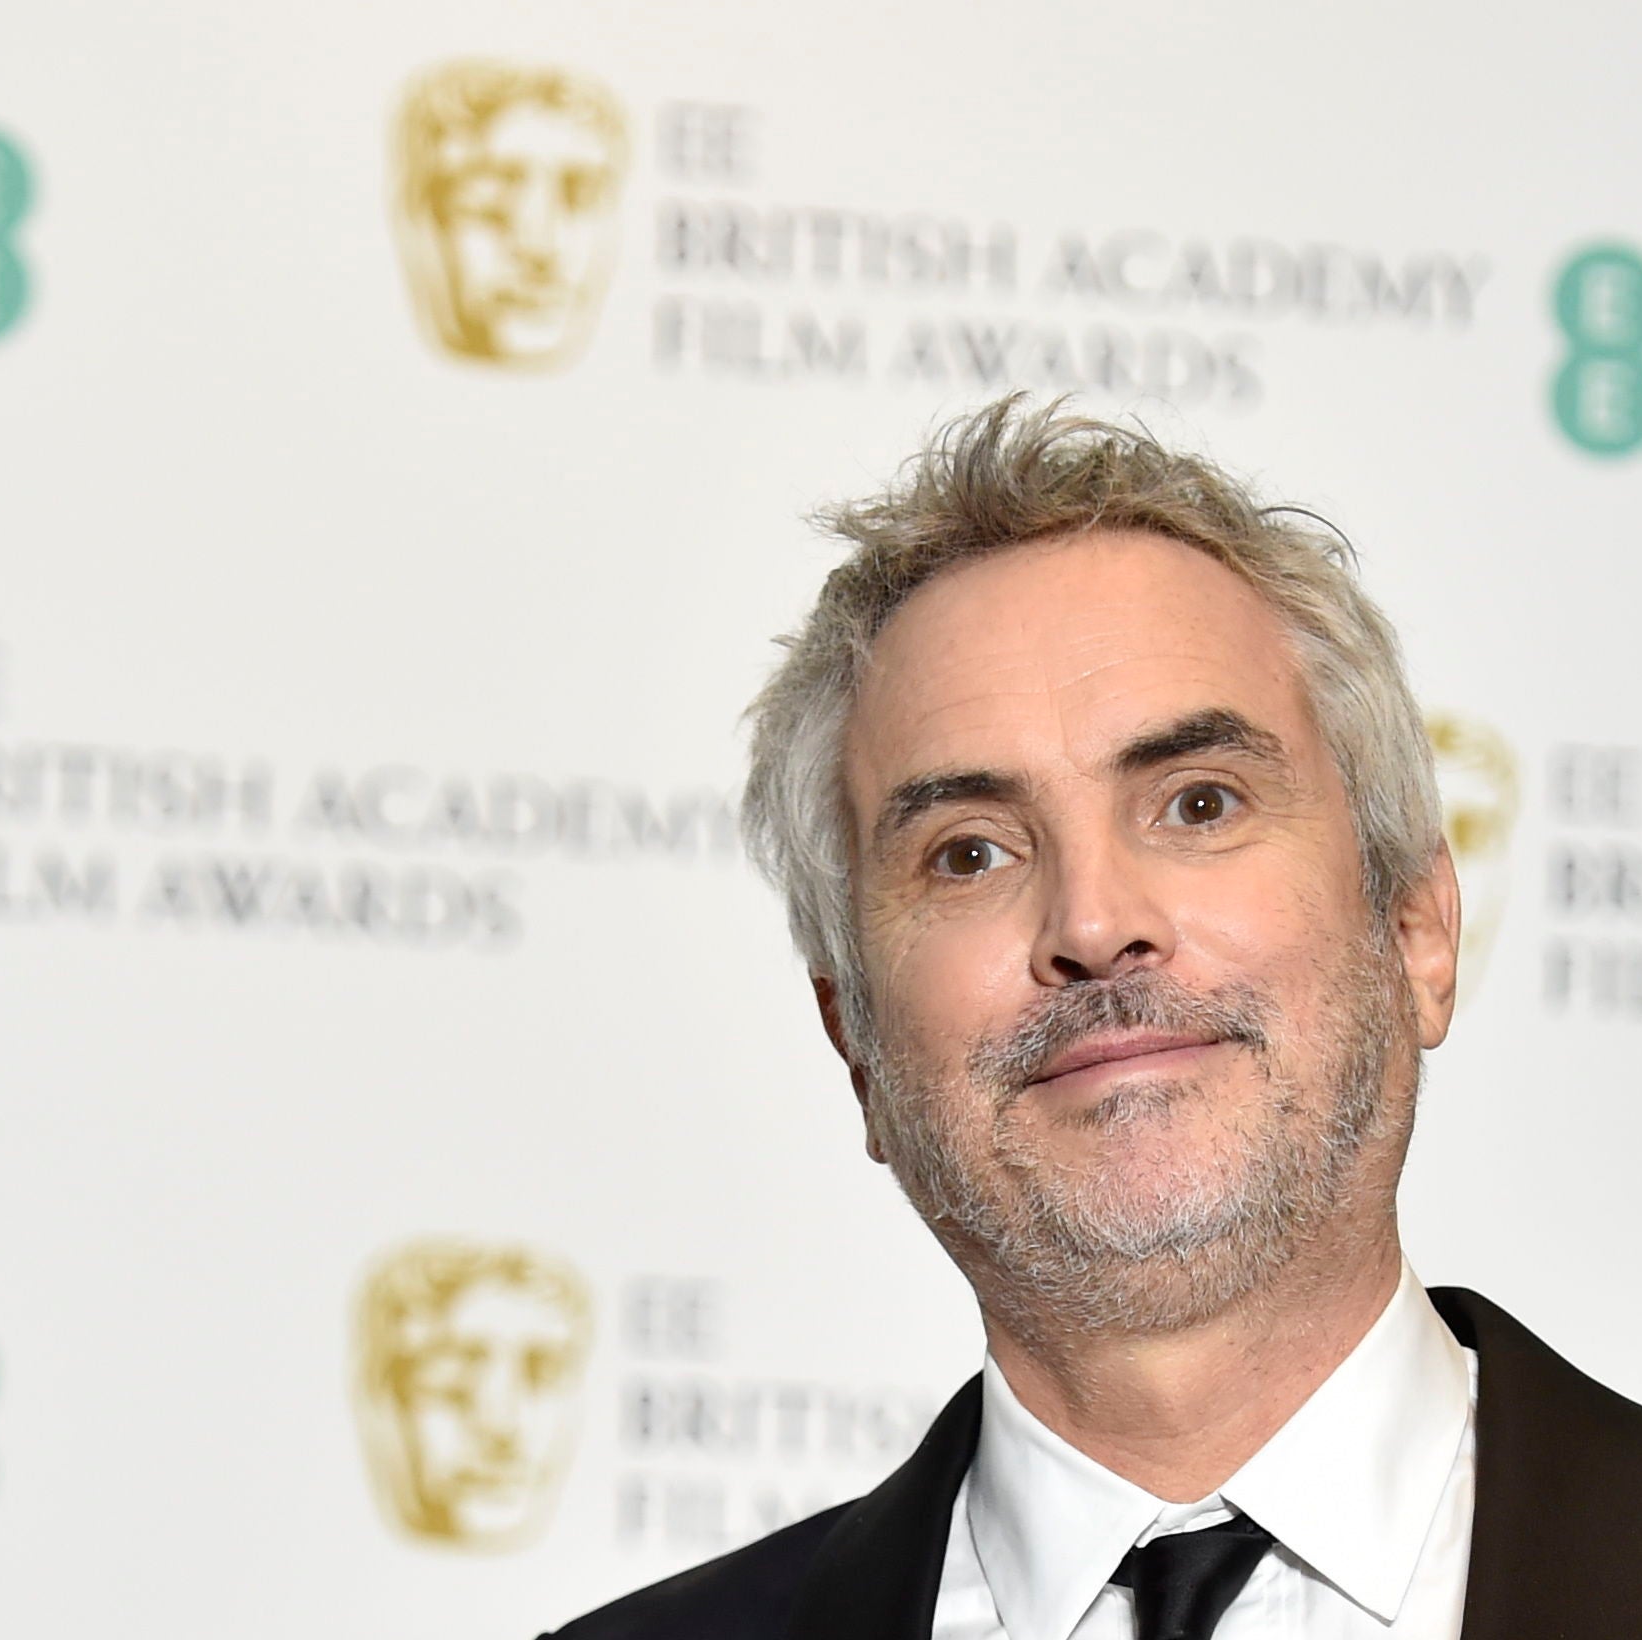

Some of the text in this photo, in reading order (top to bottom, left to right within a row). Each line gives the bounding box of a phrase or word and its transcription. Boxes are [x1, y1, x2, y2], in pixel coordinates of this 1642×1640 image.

[655, 201, 1486, 330] BRITISH ACADEMY
[652, 297, 1263, 408] FILM AWARDS
[141, 857, 522, 952] AWARDS
